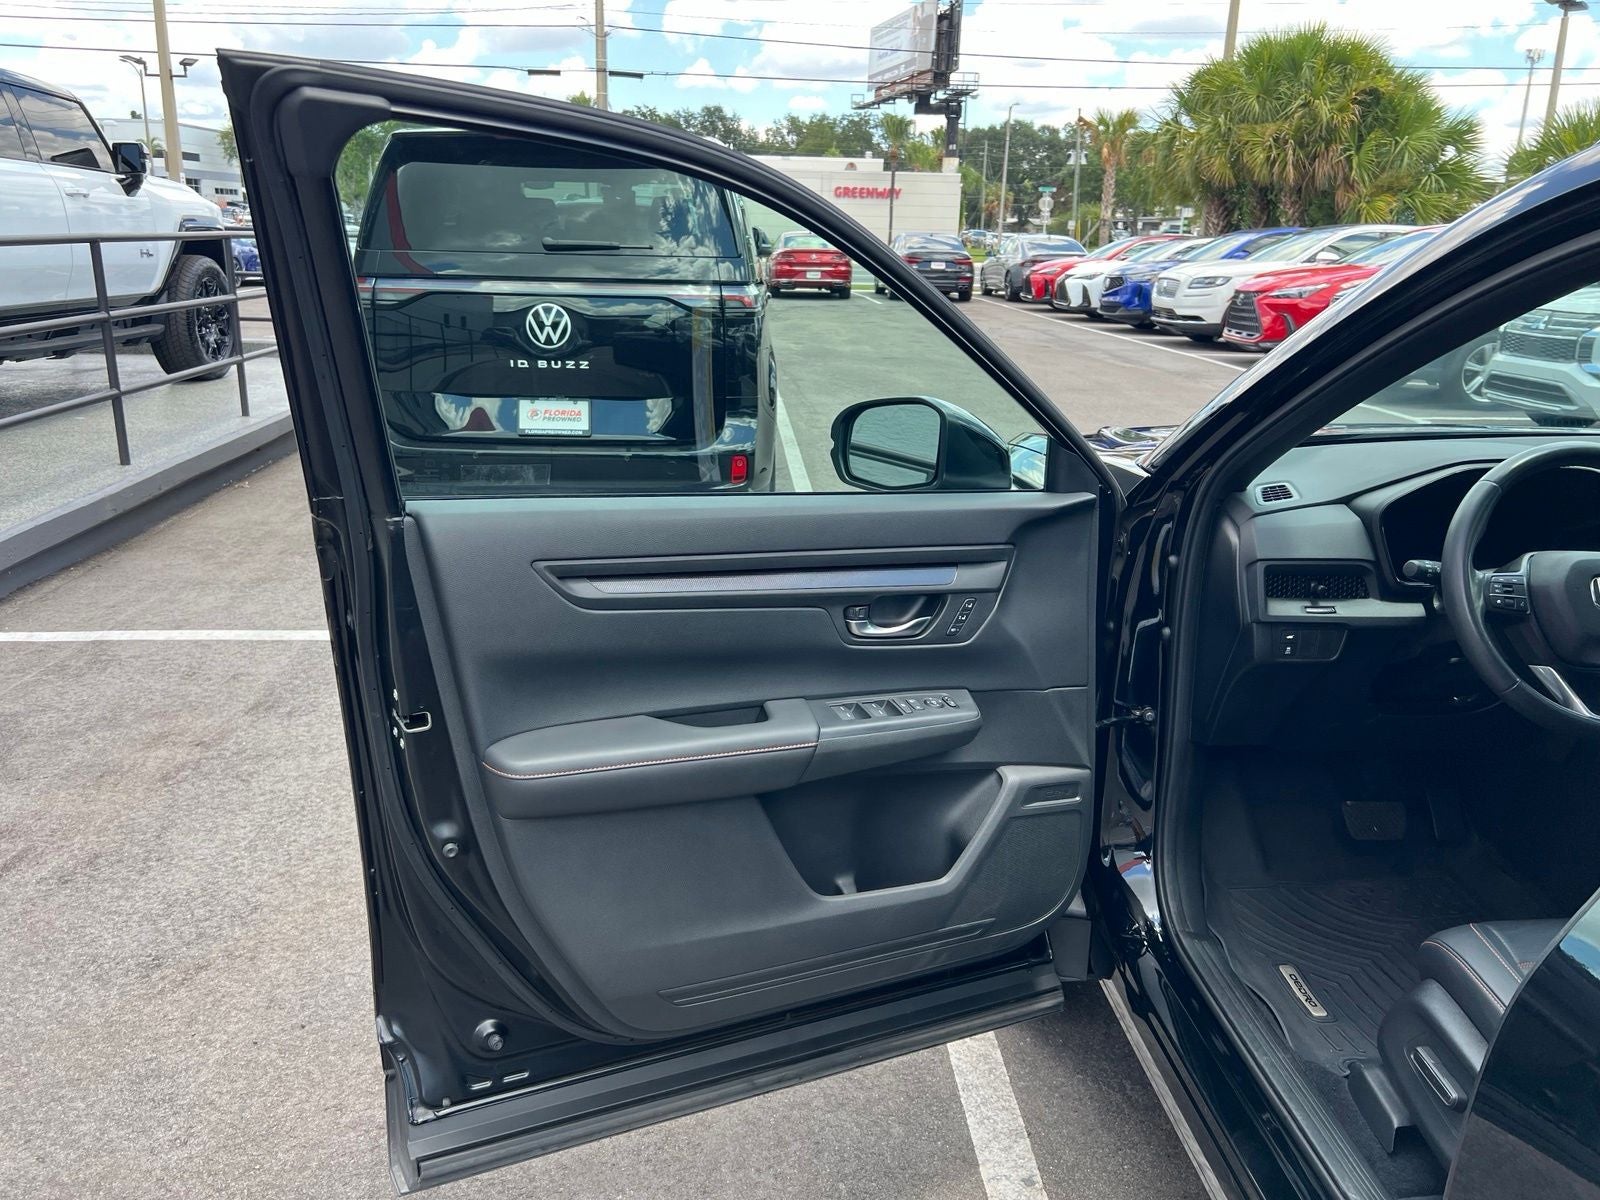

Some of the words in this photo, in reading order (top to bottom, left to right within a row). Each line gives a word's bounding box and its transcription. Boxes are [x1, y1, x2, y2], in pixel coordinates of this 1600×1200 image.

[834, 186, 902, 199] GREENWAY
[537, 360, 590, 369] BUZZ
[543, 409, 582, 417] FLORIDA
